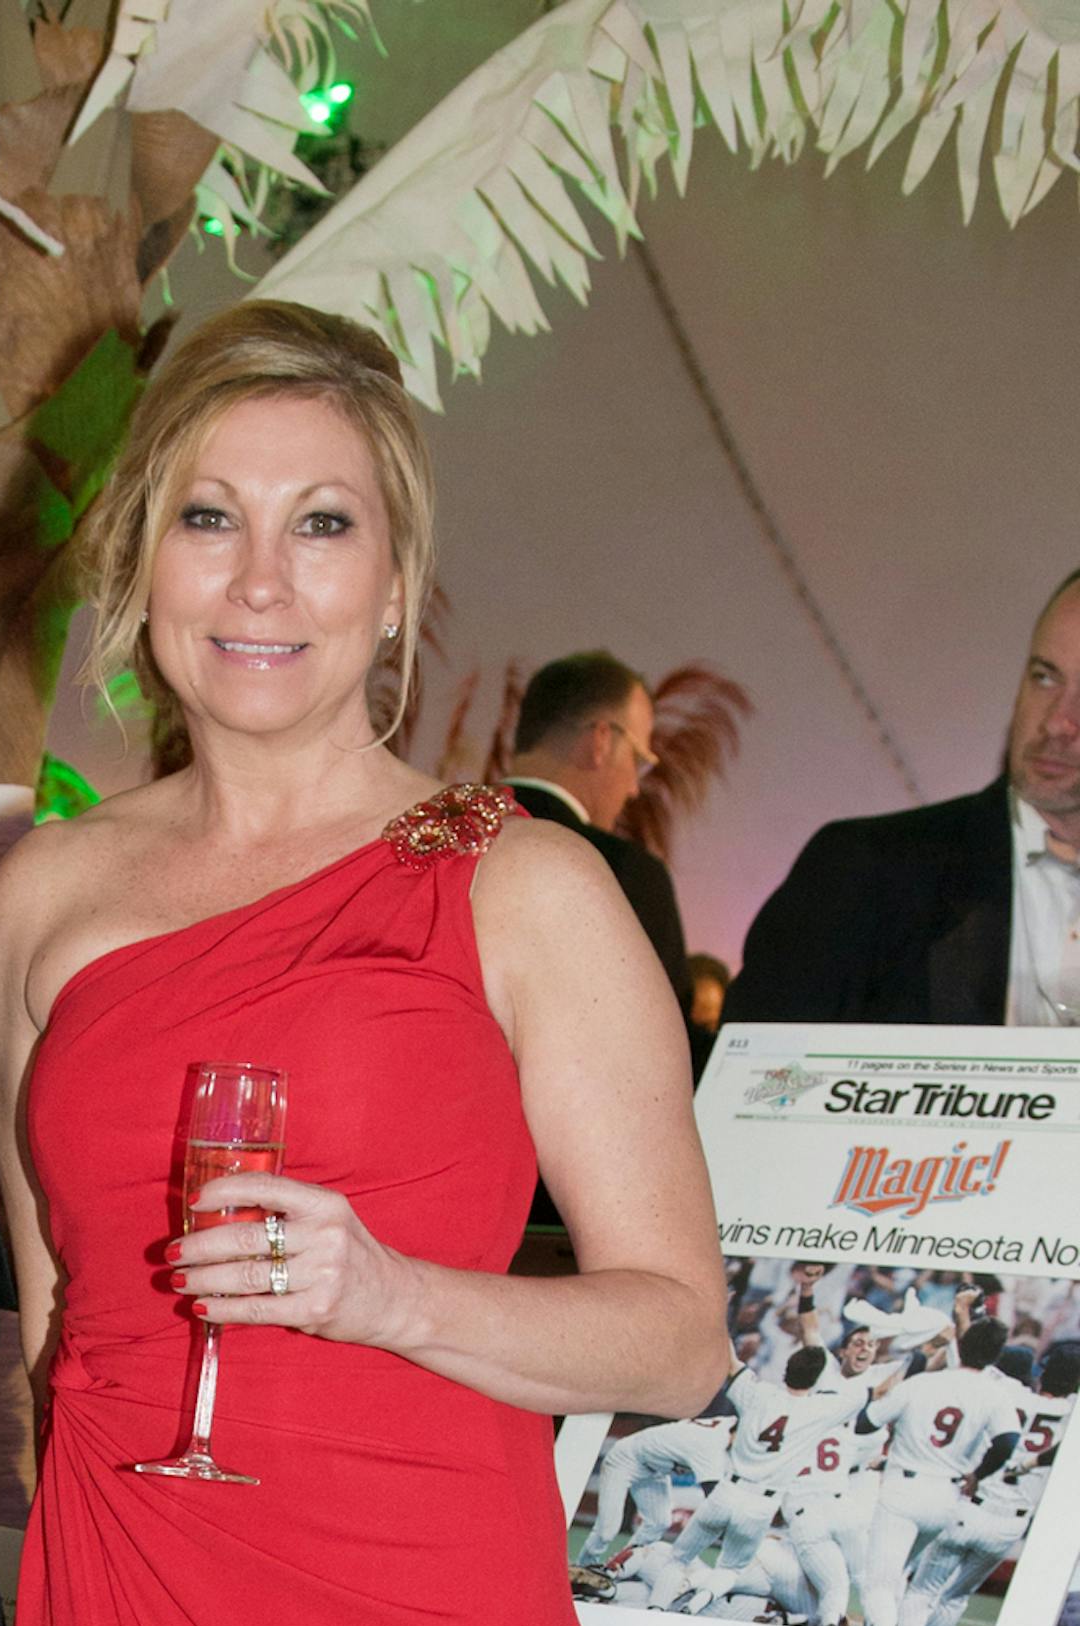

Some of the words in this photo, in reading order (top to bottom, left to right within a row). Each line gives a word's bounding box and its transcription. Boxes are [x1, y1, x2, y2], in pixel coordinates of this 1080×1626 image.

[860, 1061, 893, 1072] pages
[896, 1062, 911, 1070] on
[913, 1061, 930, 1071] the
[933, 1061, 966, 1072] Series
[970, 1063, 981, 1073] in
[983, 1063, 1014, 1073] News
[1017, 1063, 1038, 1074] and
[1041, 1063, 1078, 1075] Sports
[824, 1079, 909, 1114] Star
[913, 1082, 1056, 1121] Tribune
[829, 1139, 1012, 1219] Magic!
[718, 1217, 771, 1246] wins
[774, 1222, 858, 1251] make
[864, 1225, 1022, 1263] Minnesota
[758, 1415, 790, 1452] 4
[930, 1406, 964, 1449] 9
[1016, 1407, 1062, 1453] 5
